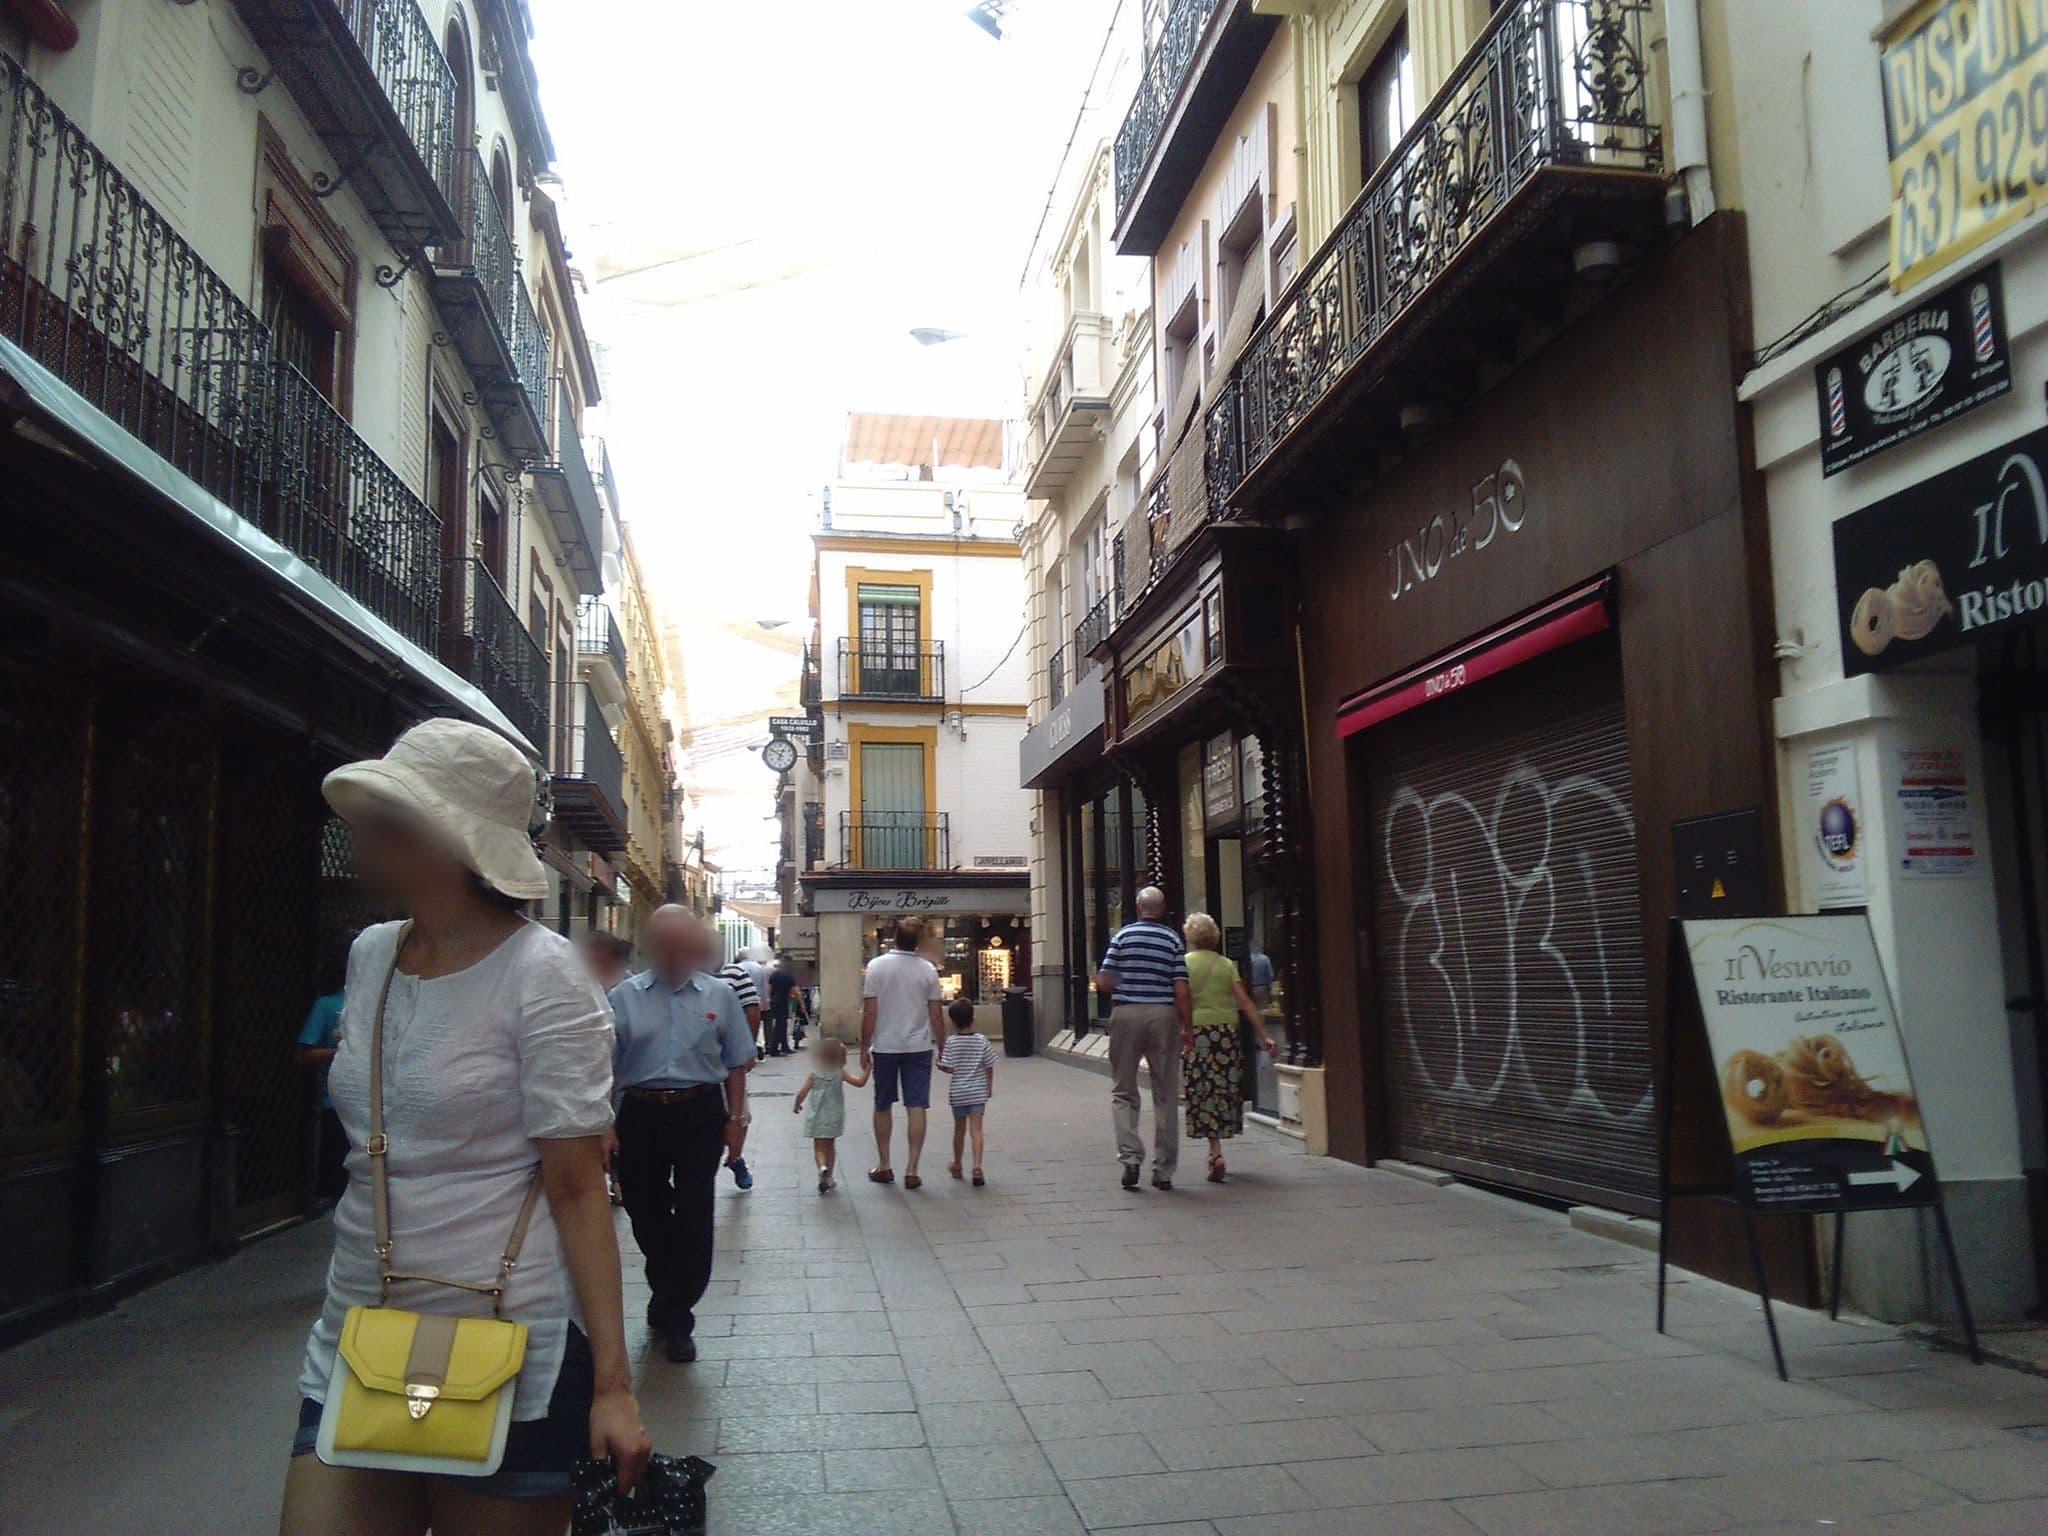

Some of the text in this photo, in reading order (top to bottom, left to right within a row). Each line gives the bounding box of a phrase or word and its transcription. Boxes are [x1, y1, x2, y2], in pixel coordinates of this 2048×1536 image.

[1900, 132, 1960, 264] 637
[1472, 459, 1526, 551] 50
[849, 891, 950, 909] Bijou Brigitte
[1739, 945, 1852, 980] Vesuvio
[1717, 985, 1871, 1005] Ristorante Italiano
